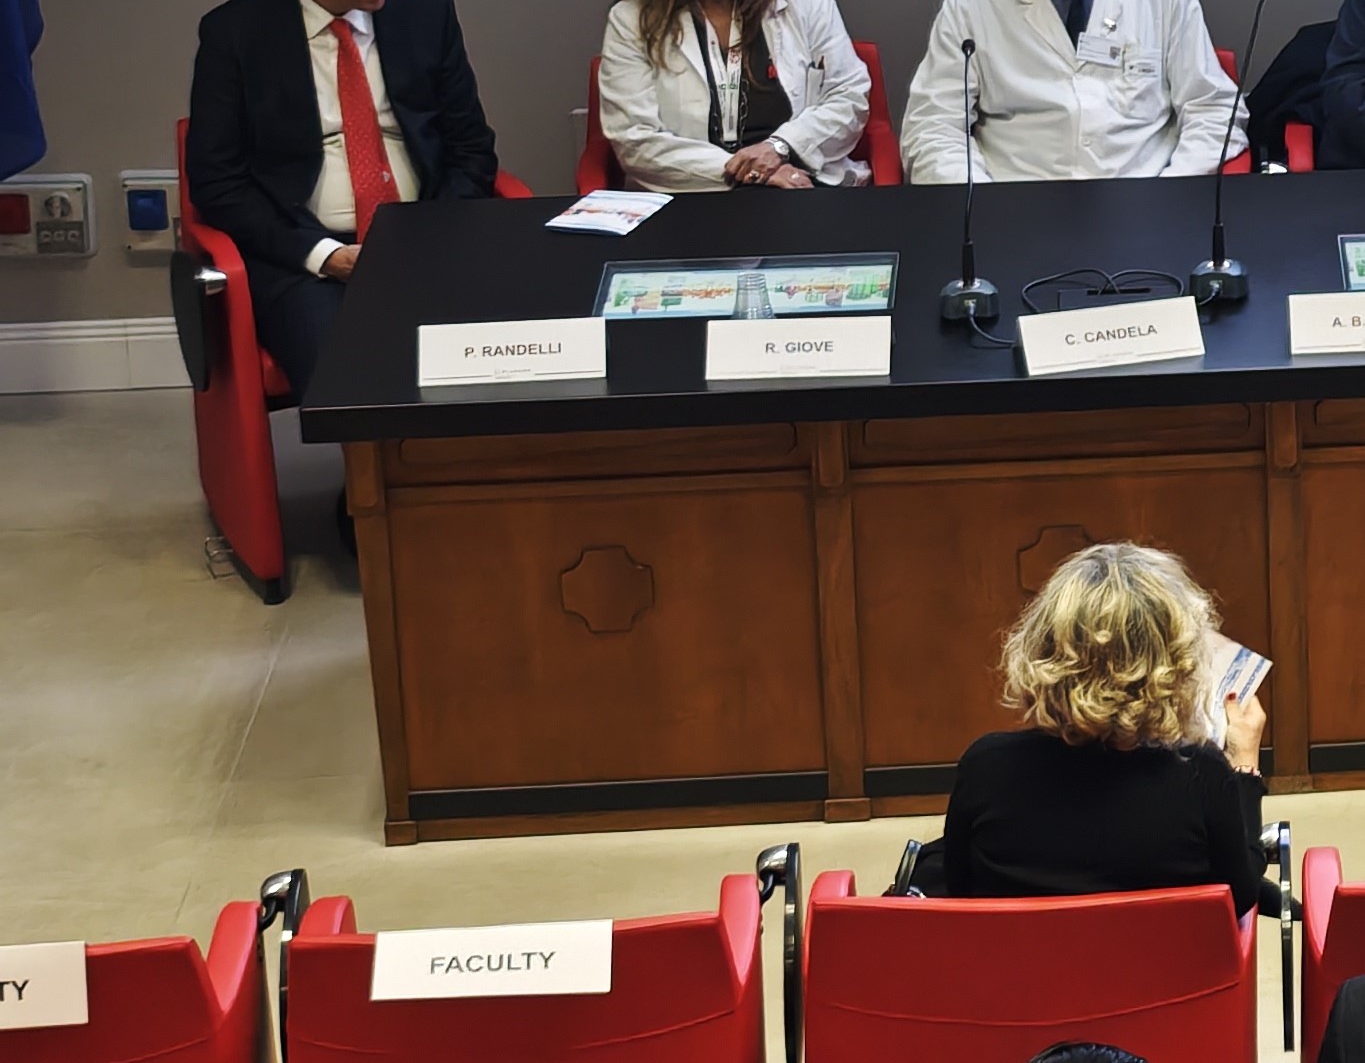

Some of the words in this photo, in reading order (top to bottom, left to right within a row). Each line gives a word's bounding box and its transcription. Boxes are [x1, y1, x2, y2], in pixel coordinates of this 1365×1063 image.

[1331, 316, 1348, 328] A.
[1064, 333, 1081, 346] C.
[1084, 324, 1158, 343] CANDELA
[464, 346, 478, 358] P.
[481, 342, 562, 357] RANDELLI
[765, 342, 781, 354] R.
[784, 340, 834, 354] GIOVE
[430, 951, 556, 975] FACULTY
